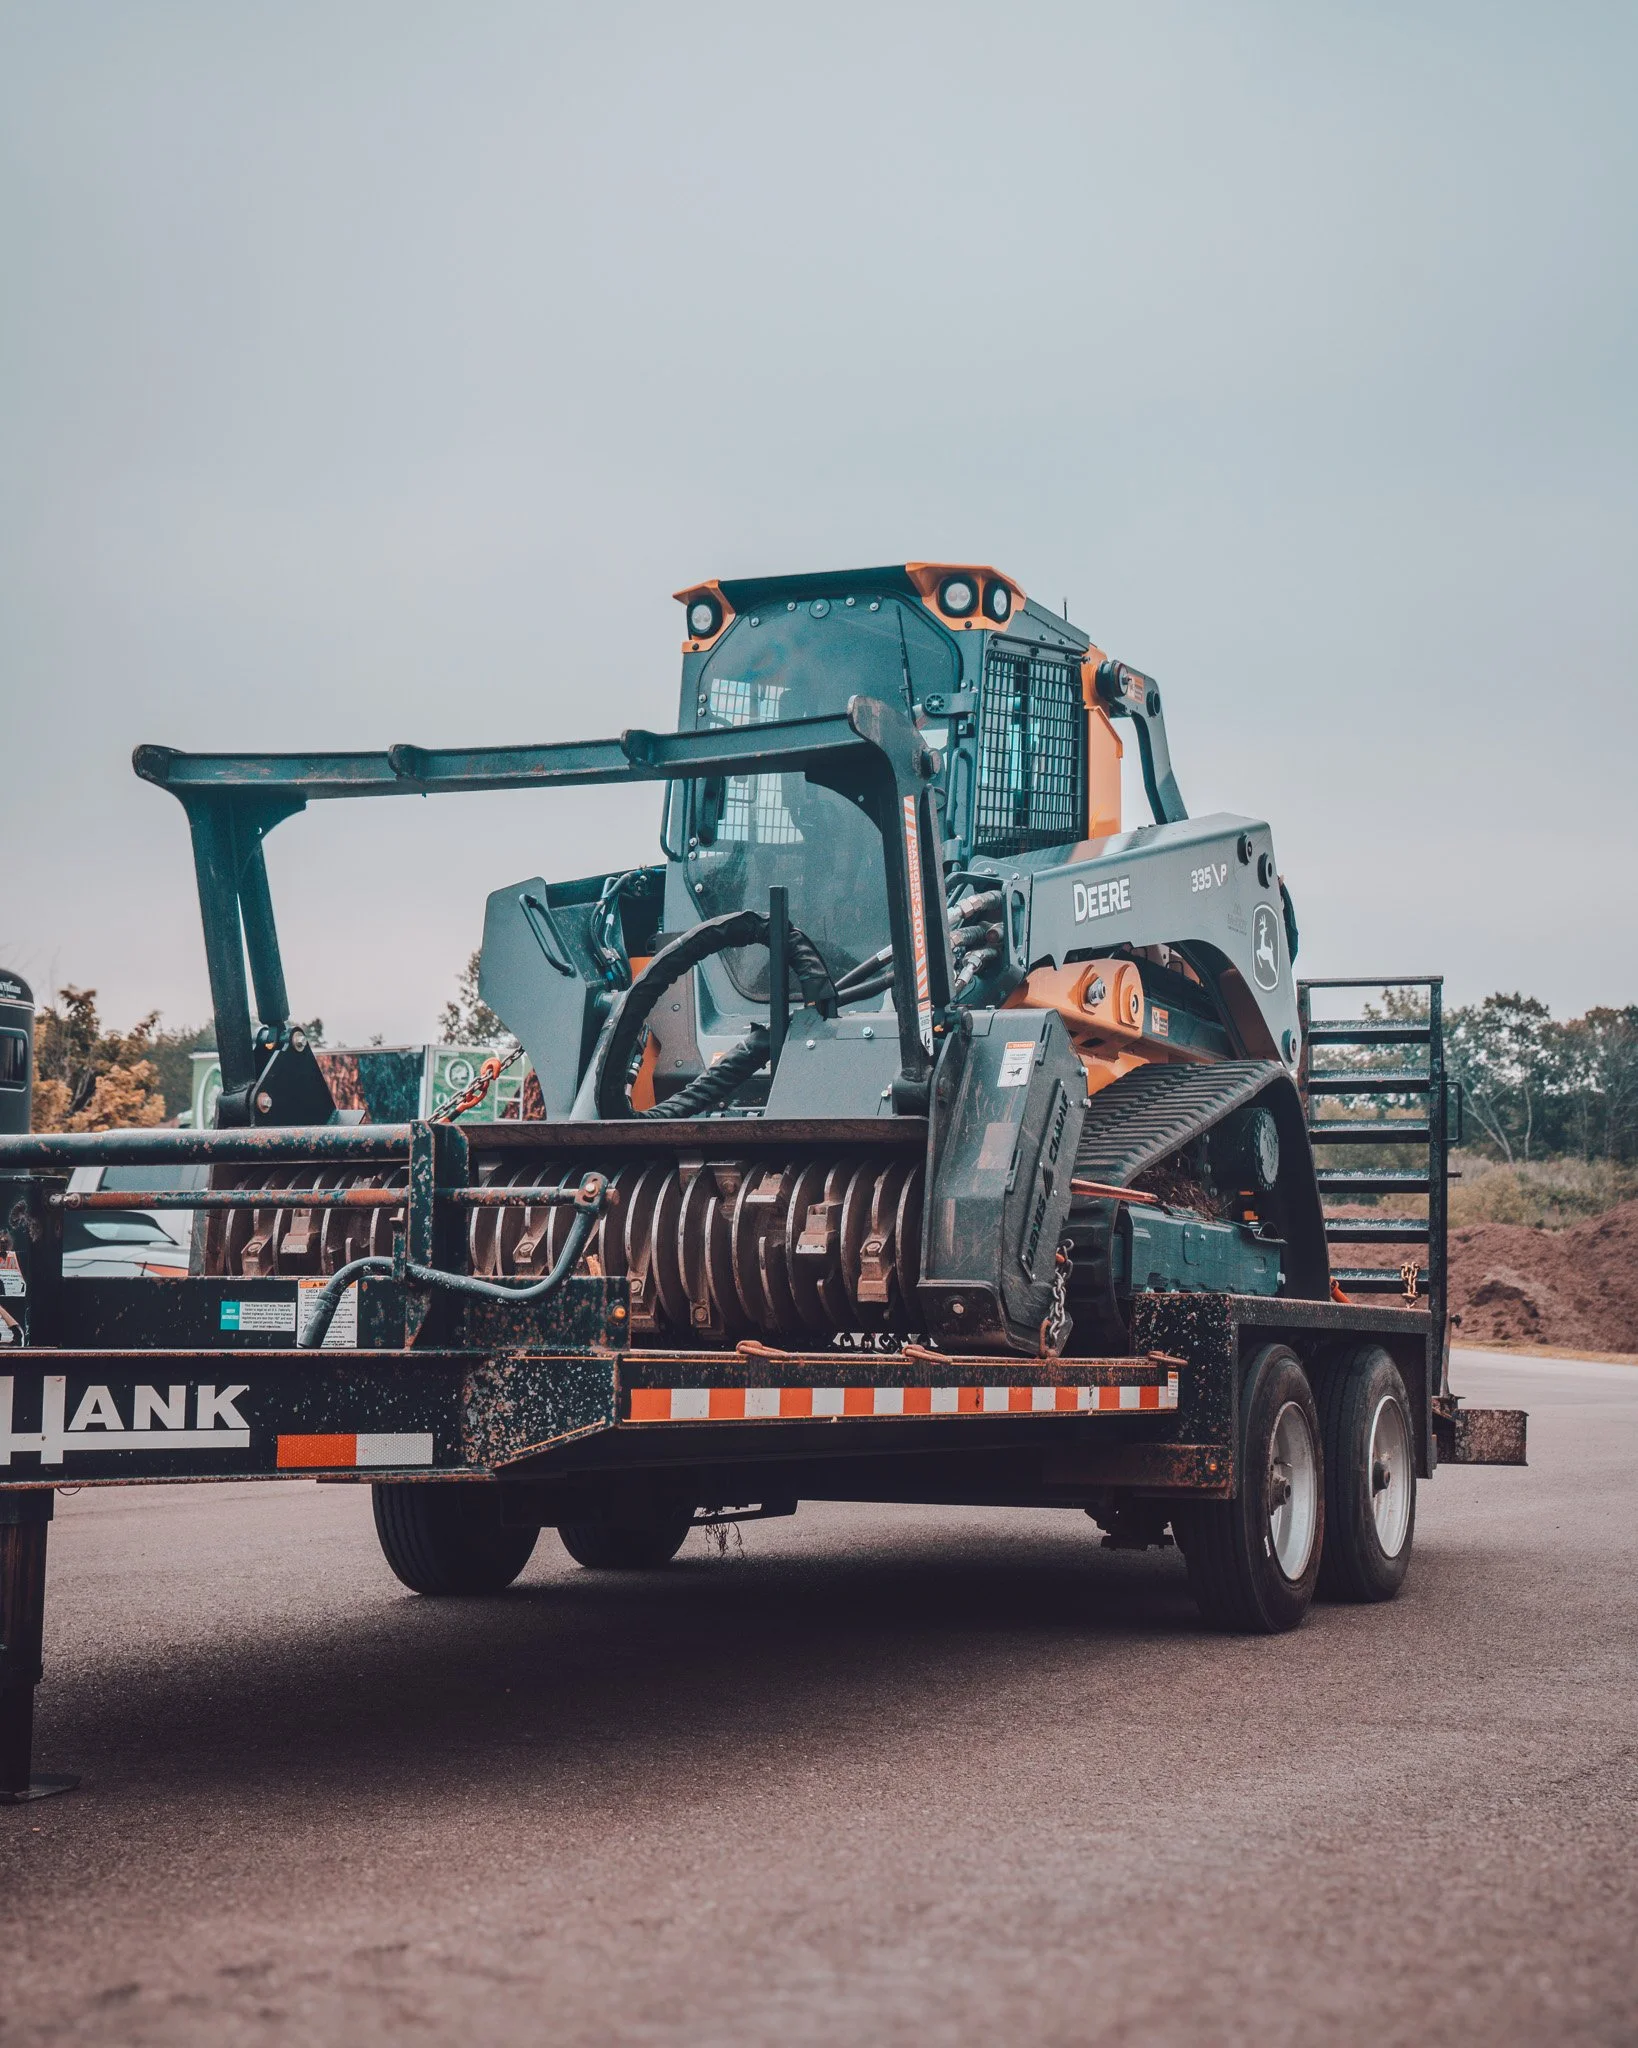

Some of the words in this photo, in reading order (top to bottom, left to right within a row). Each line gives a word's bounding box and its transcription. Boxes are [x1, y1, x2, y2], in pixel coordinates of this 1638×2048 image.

[911, 839, 921, 901] DANGER
[1073, 876, 1131, 923] DEERE
[0, 1375, 250, 1466] HANK
